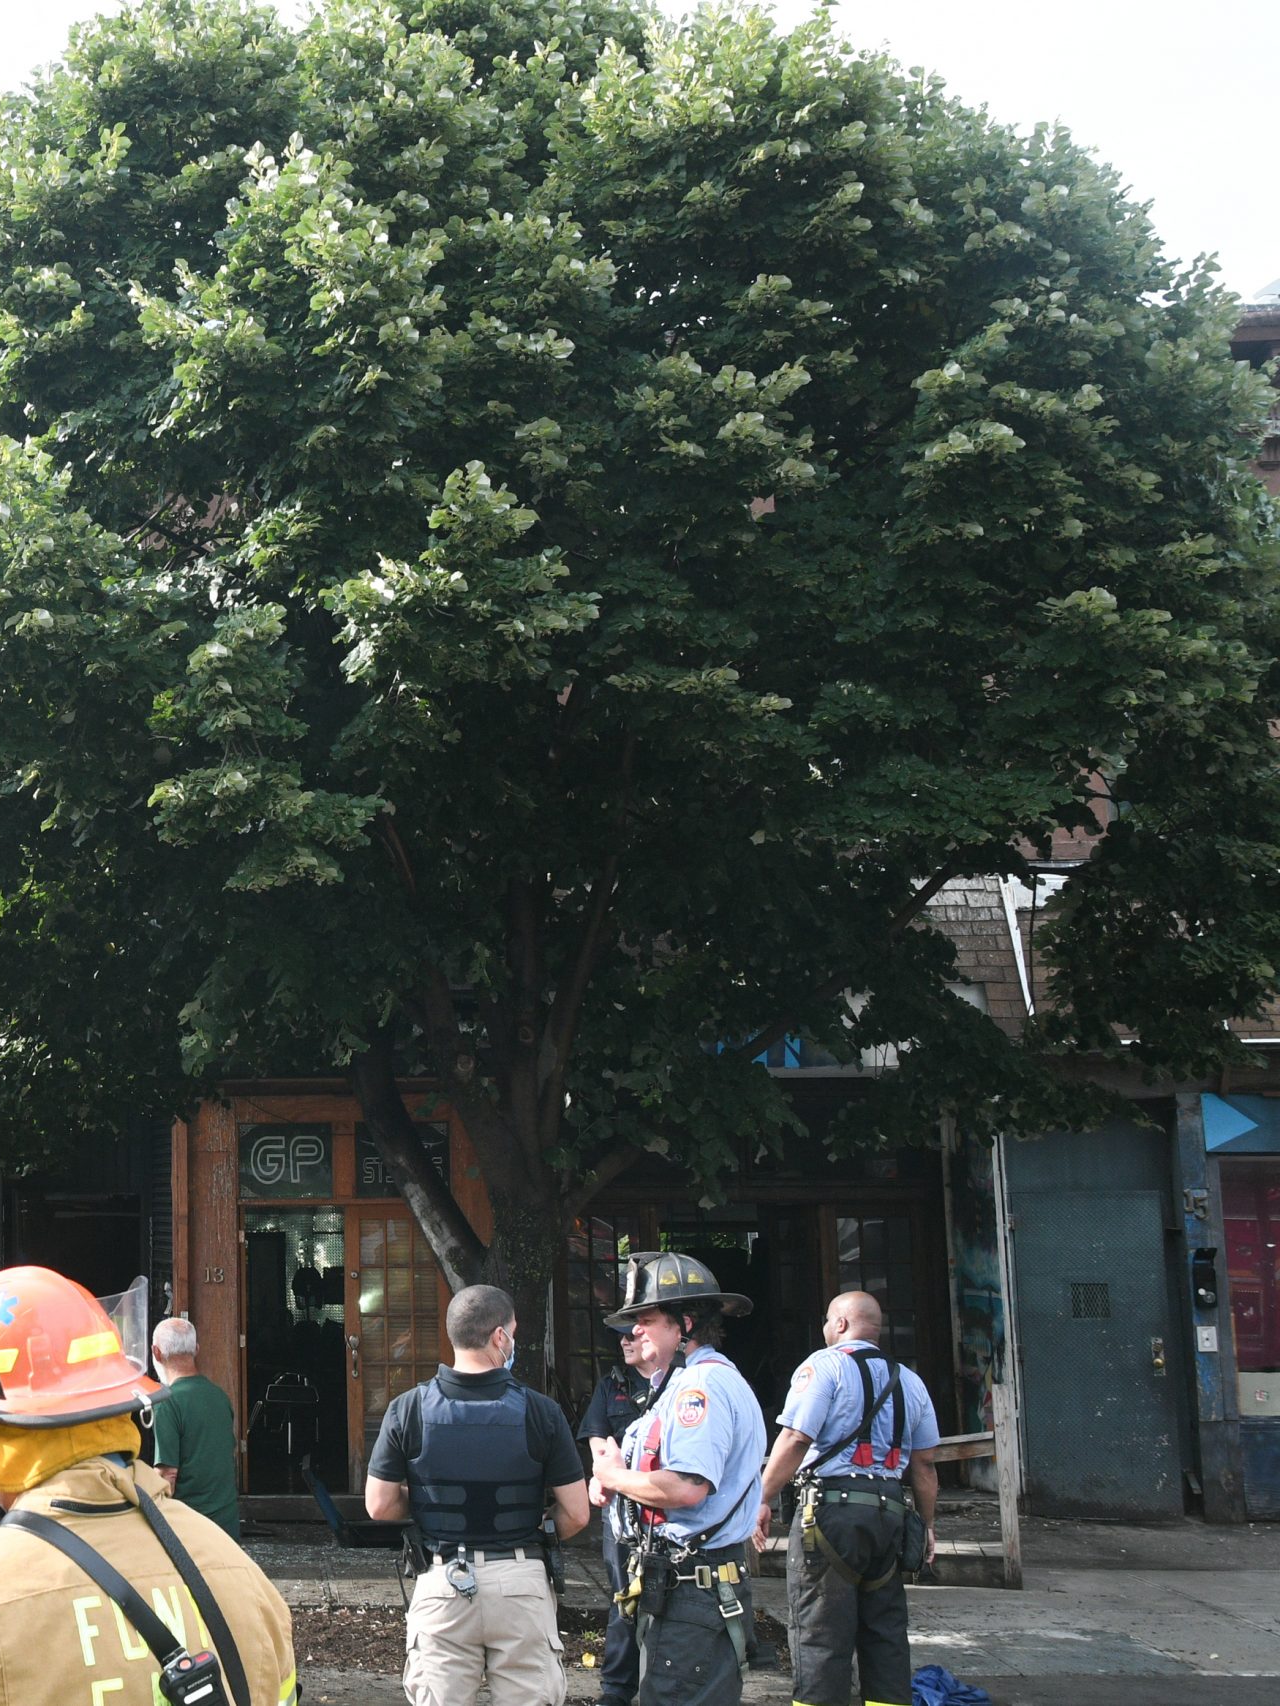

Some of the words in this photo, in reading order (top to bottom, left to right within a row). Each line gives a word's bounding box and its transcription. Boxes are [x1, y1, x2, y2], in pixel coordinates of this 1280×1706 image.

[250, 1135, 325, 1185] GP
[1184, 1189, 1208, 1219] 15
[203, 1267, 224, 1283] 13
